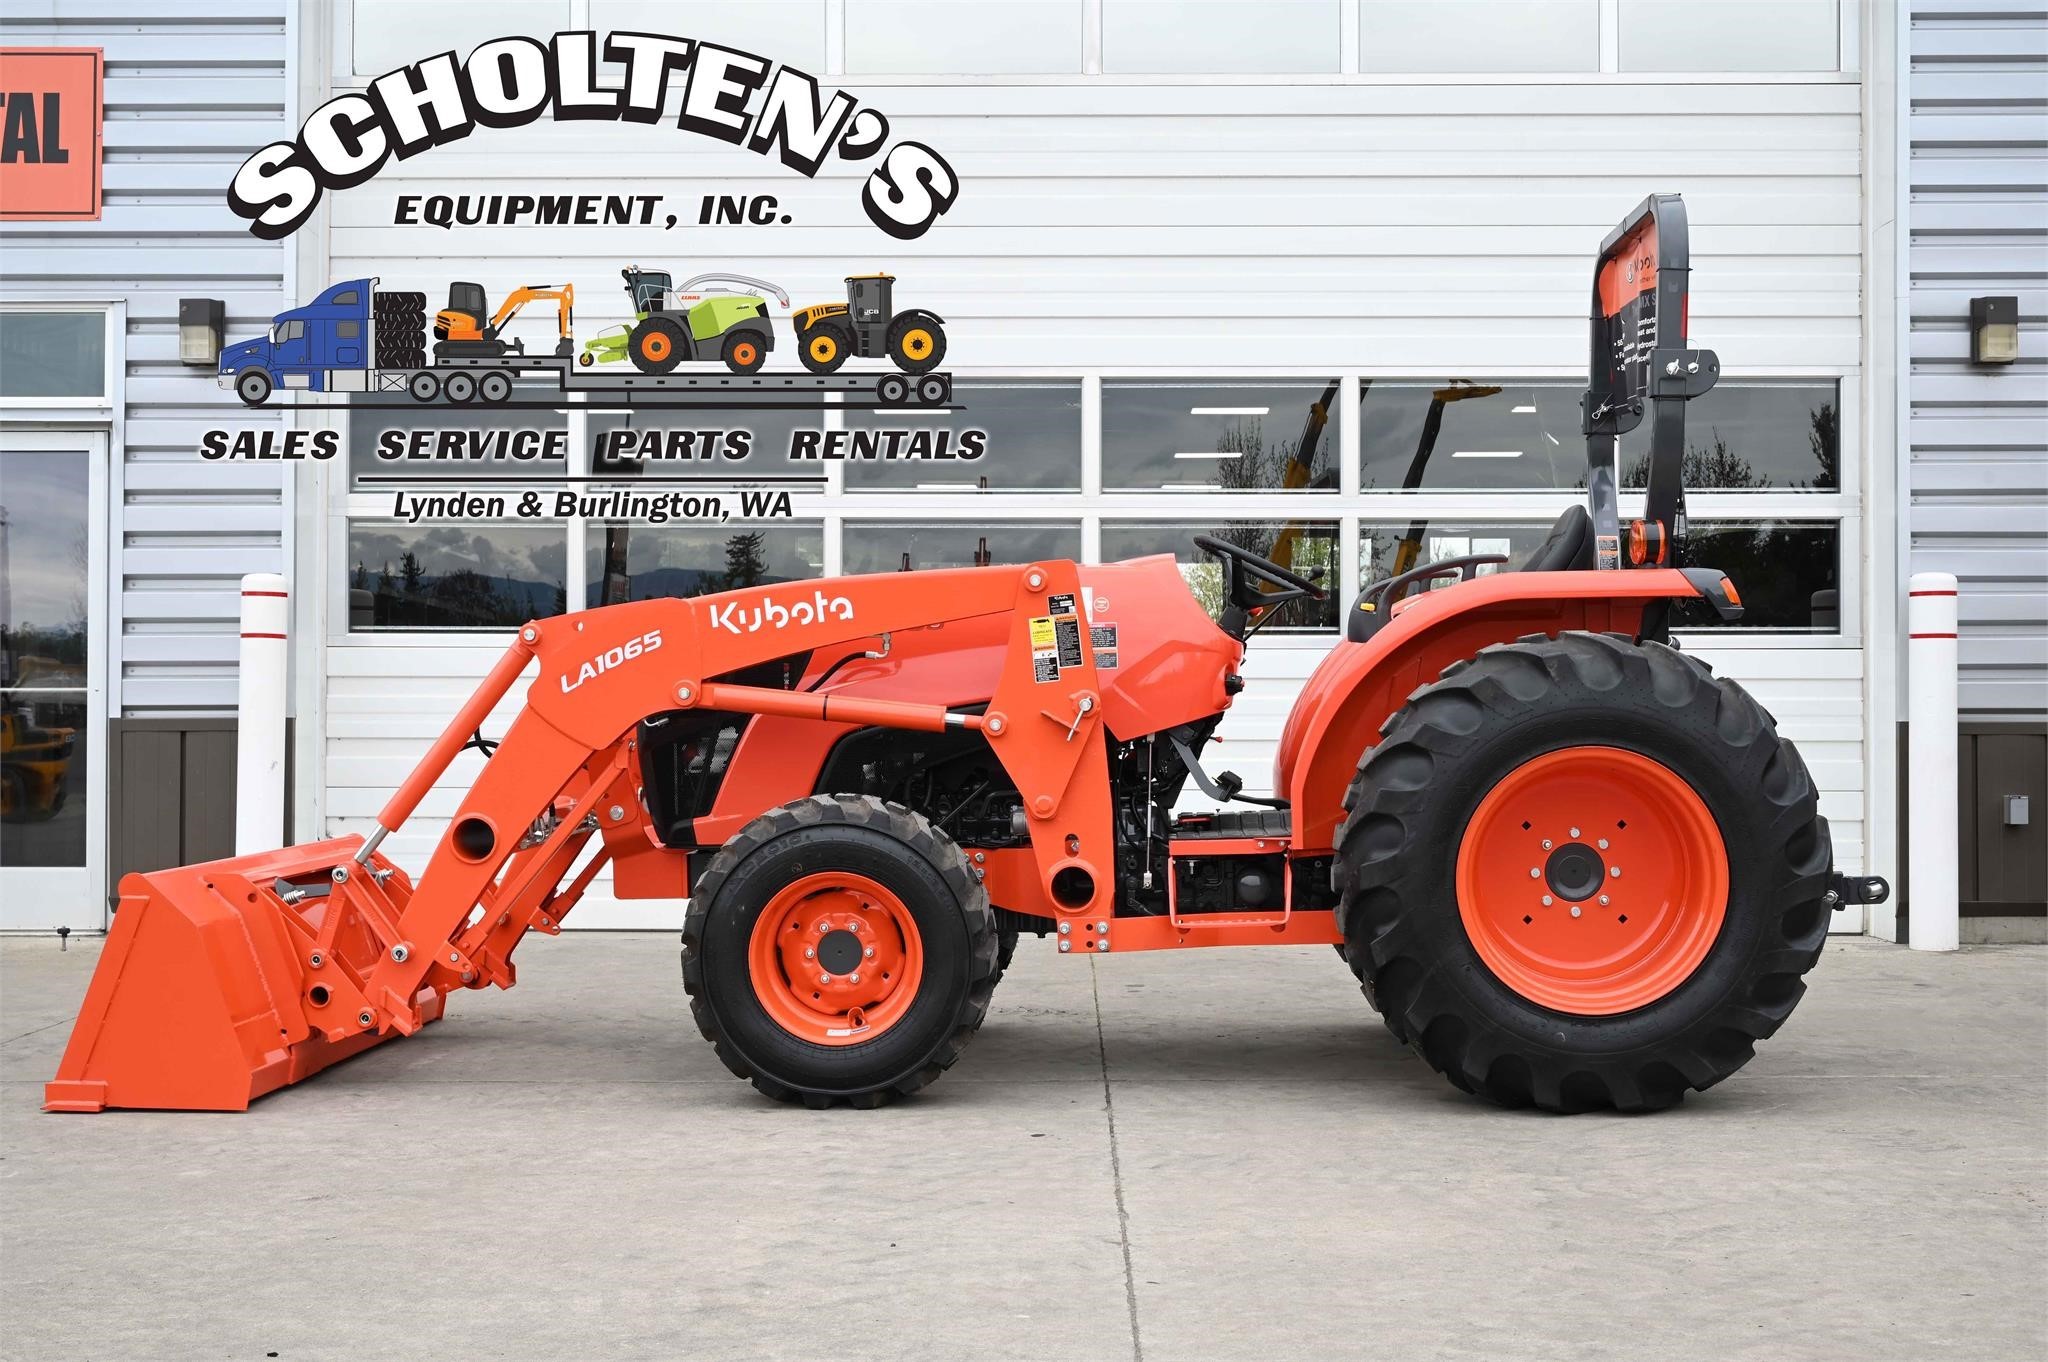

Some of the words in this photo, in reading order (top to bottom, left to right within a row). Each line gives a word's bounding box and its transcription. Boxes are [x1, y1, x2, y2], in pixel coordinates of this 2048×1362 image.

[0, 93, 69, 163] AL
[709, 590, 854, 634] Kubota
[560, 629, 663, 694] LA1065
